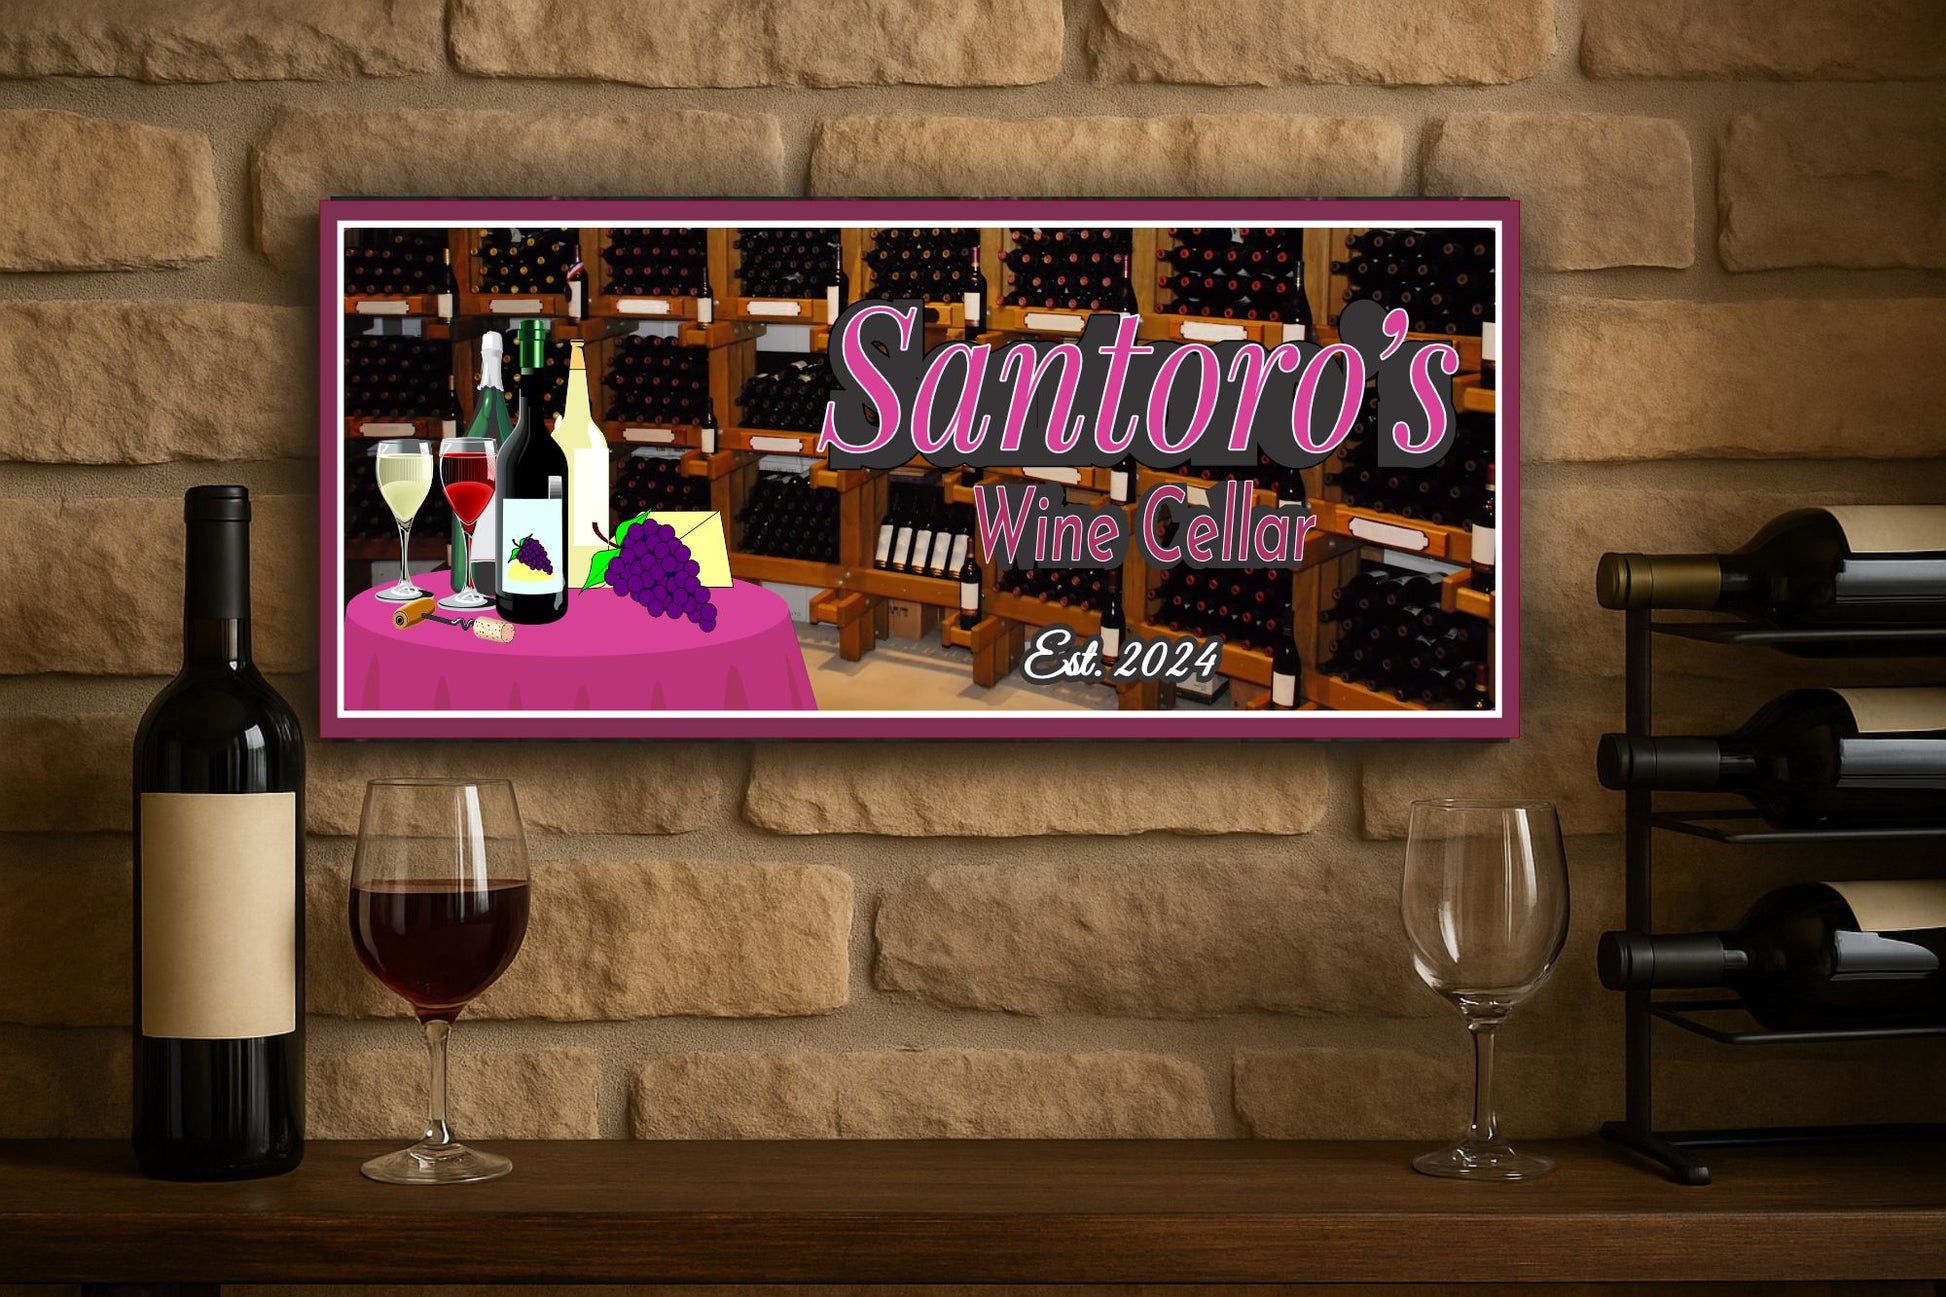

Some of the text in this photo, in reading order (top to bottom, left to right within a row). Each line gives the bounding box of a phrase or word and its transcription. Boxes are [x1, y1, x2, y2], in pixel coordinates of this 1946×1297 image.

[817, 306, 1459, 454] Santoro's
[973, 480, 1317, 565] Wine Cellar
[1023, 628, 1219, 680] Est. 2024
